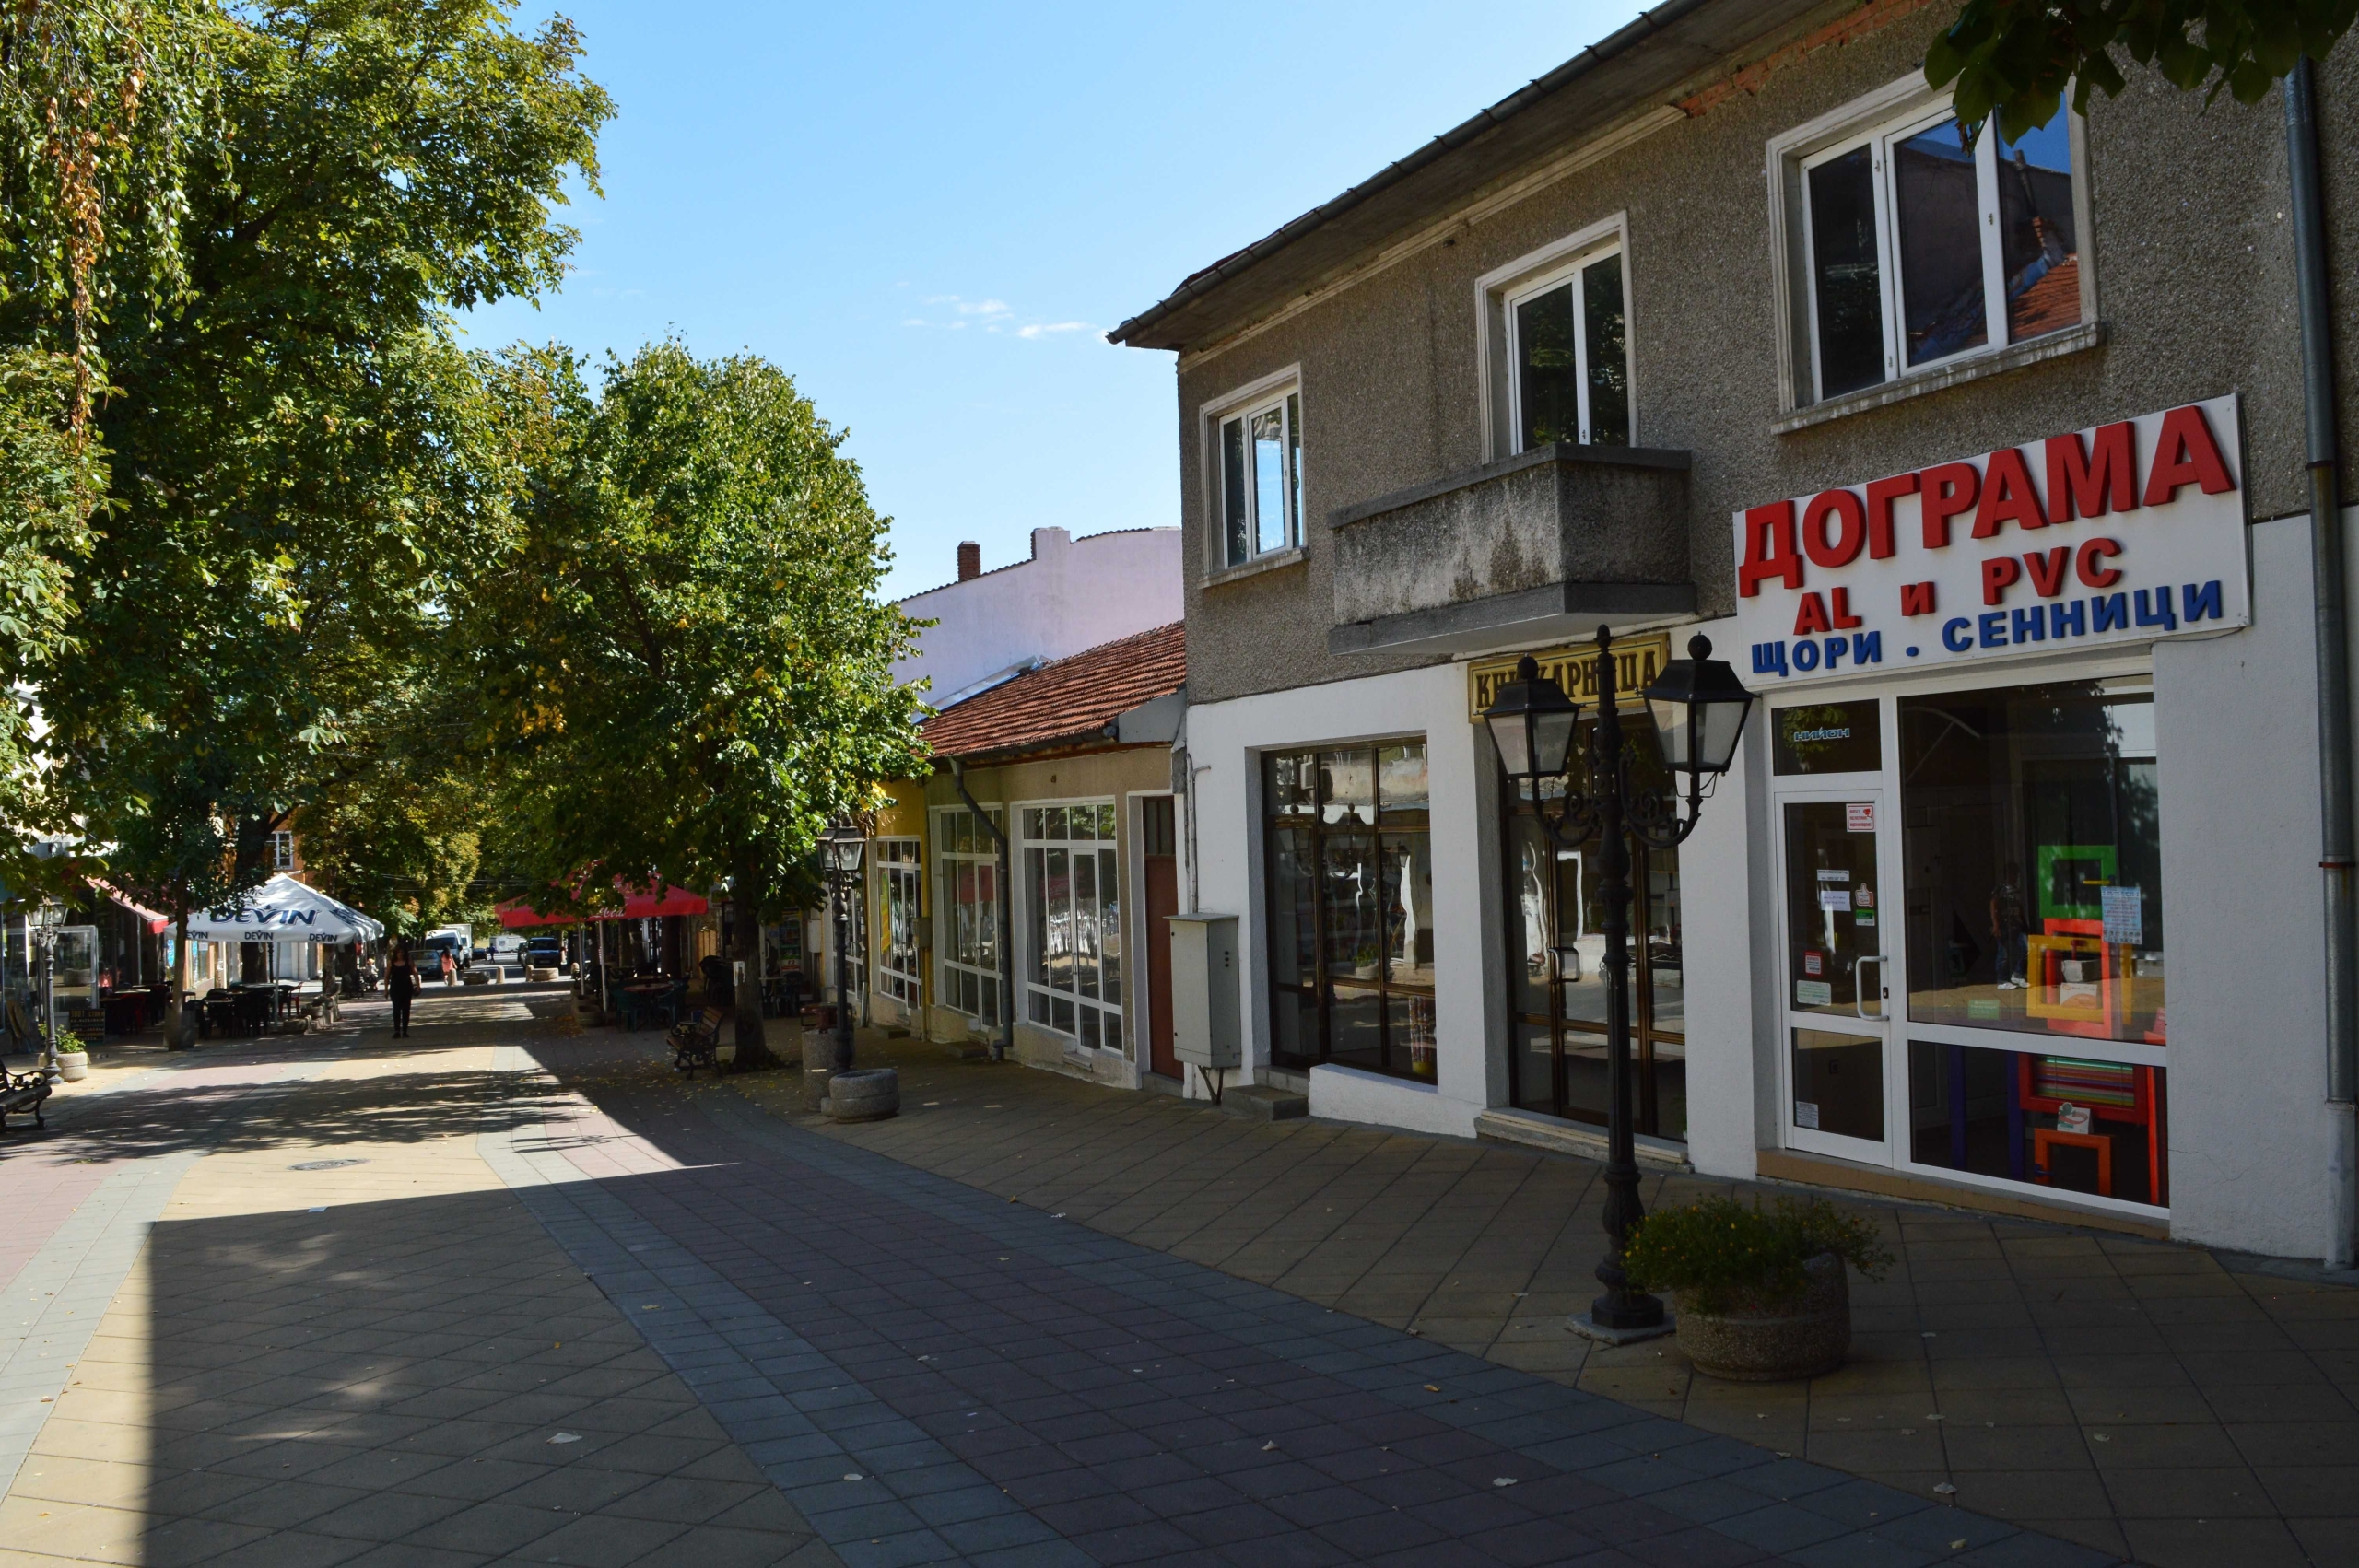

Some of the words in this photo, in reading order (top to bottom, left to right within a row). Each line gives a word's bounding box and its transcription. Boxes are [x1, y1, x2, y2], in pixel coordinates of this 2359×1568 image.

[1739, 405, 2236, 597] ДОГРАМА
[1793, 587, 1862, 635] AL
[1981, 537, 2122, 605] PVC
[1752, 630, 1881, 677] ЩОРИ
[1942, 579, 2222, 652] СЕННИЦИ
[1794, 726, 1850, 742] НИЙОН
[209, 905, 319, 926] DEVIN
[186, 930, 208, 940] EVIN
[244, 930, 274, 941] DEVIN
[309, 932, 339, 942] DEVIN
